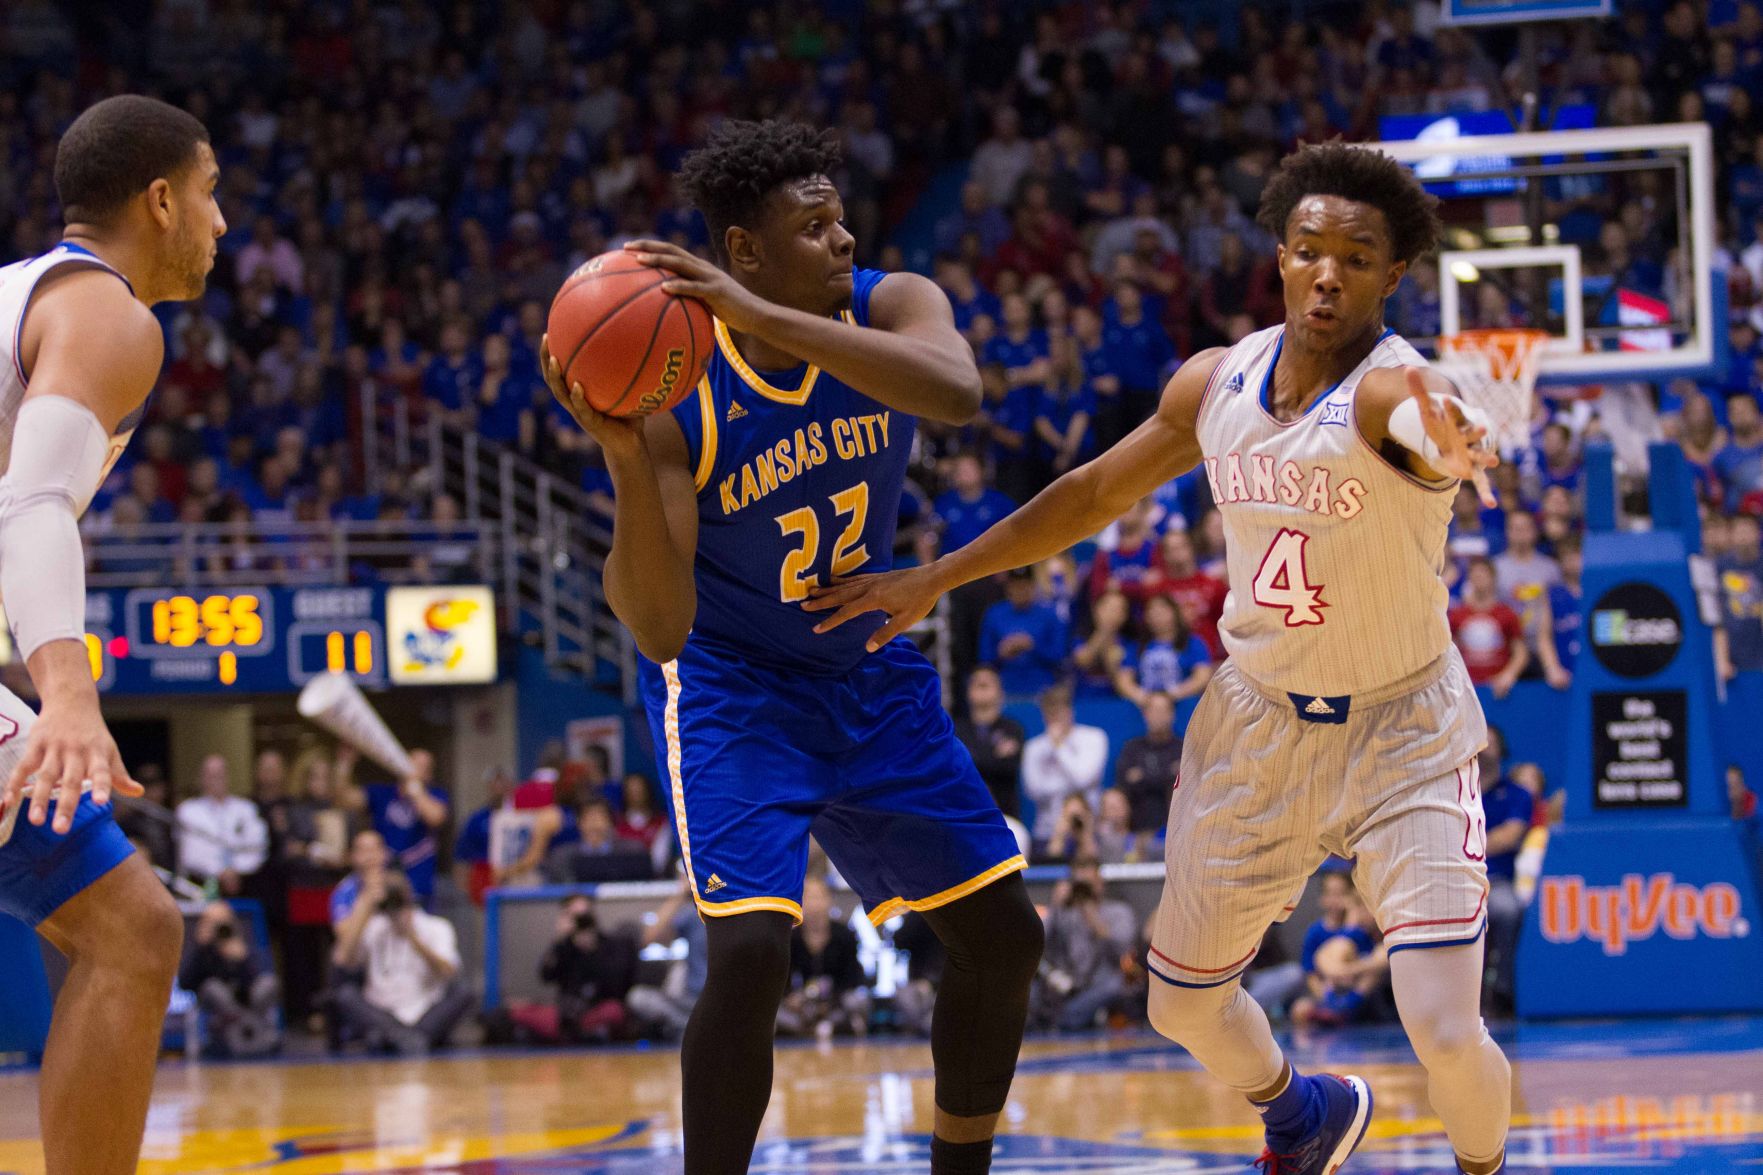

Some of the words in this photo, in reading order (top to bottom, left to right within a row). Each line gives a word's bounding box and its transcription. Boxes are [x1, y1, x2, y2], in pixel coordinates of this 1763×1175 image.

[727, 408, 749, 422] adidas
[719, 421, 828, 515] KANSAS
[831, 411, 890, 460] CITY
[774, 481, 871, 603] 22
[1252, 528, 1331, 627] 4
[218, 650, 238, 685] 1
[326, 630, 373, 674] 11
[705, 881, 728, 894] adidas
